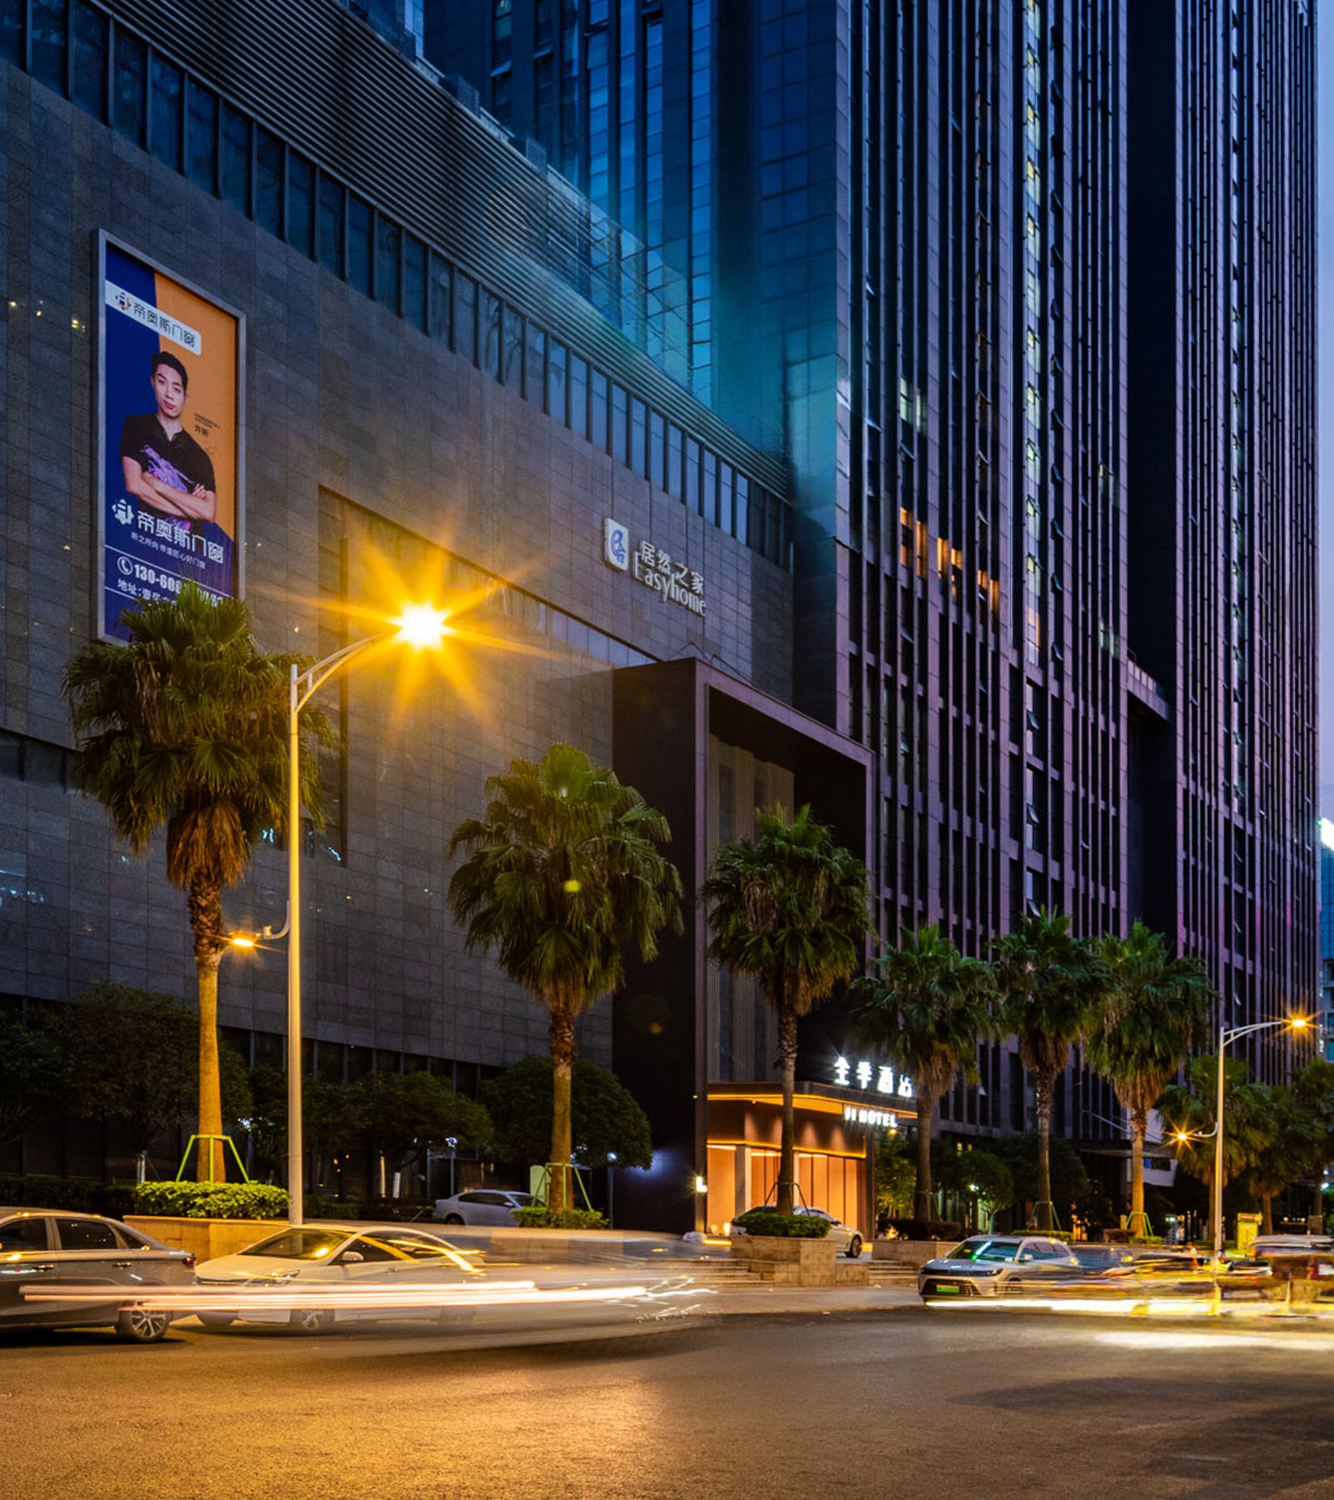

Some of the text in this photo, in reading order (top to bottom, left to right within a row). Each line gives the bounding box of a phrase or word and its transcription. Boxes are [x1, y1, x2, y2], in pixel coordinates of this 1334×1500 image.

[134, 301, 195, 348] 帝奥斯门窗
[137, 510, 224, 564] 帝奥斯门窗
[633, 551, 707, 617] Easyhome
[641, 540, 704, 595] 居然之家
[858, 1109, 898, 1128] HOTEL
